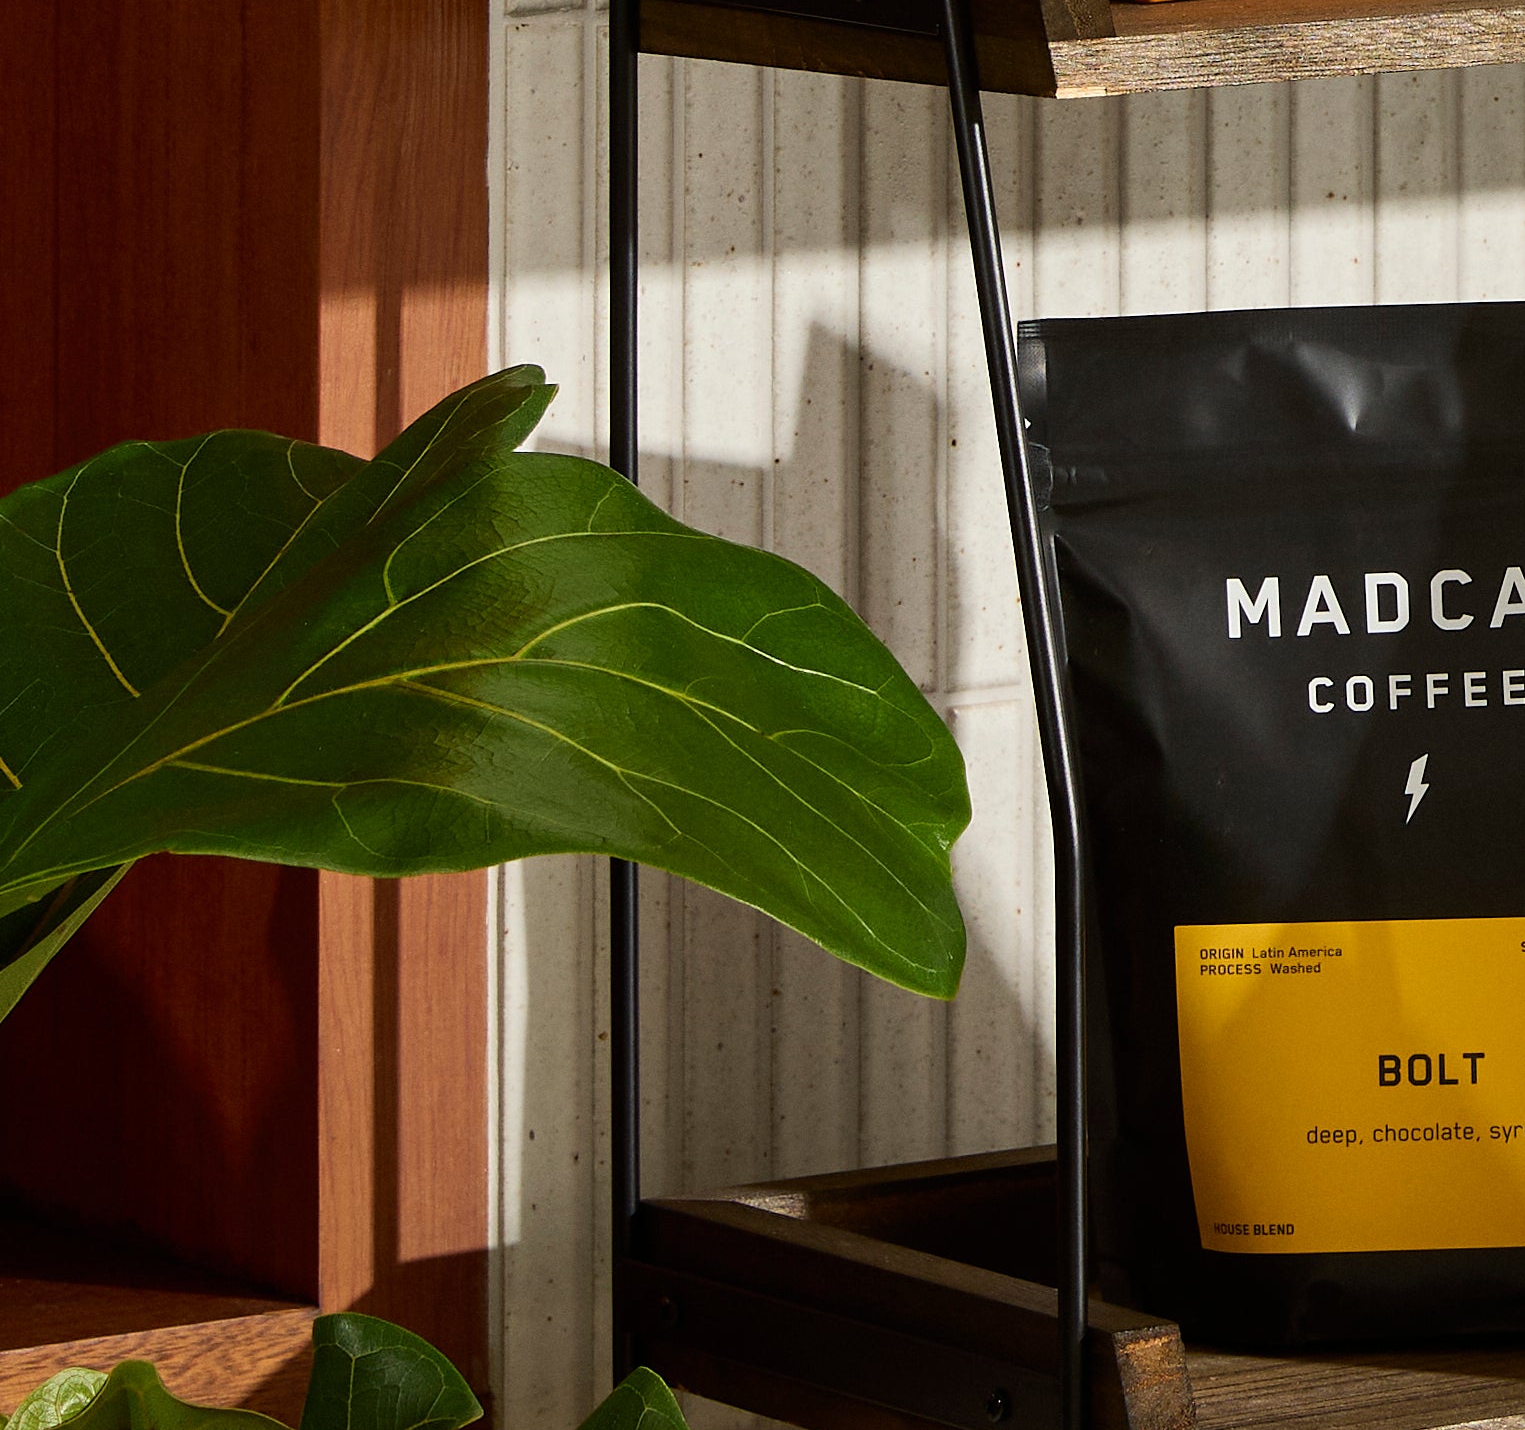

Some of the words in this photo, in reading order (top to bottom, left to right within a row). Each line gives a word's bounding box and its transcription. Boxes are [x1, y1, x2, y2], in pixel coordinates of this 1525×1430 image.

[1309, 670, 1525, 713] COFFEE
[1200, 948, 1243, 959] ORIGIN
[1253, 947, 1284, 958] Latin
[1288, 947, 1342, 957] America
[1201, 964, 1261, 975] PROCESS
[1270, 962, 1320, 974] Washed
[1379, 1053, 1485, 1086] BOLT
[1307, 1126, 1363, 1147] deep,
[1373, 1122, 1480, 1144] chocolate,
[1213, 1222, 1249, 1235] HOUSE
[1253, 1224, 1294, 1235] BLEND
